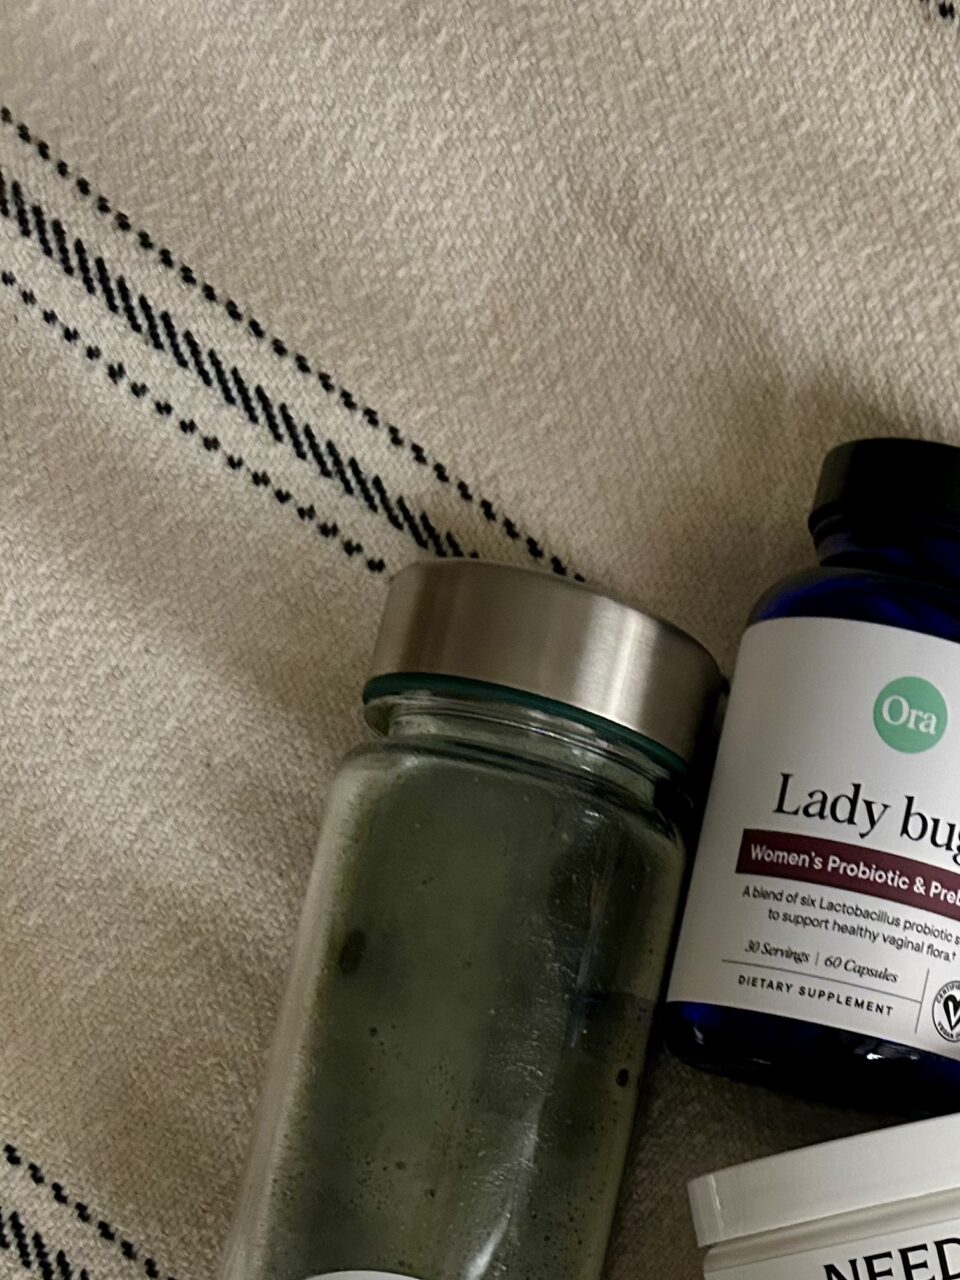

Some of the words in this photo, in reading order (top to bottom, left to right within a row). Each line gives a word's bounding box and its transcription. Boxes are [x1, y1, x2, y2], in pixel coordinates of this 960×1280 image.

[882, 695, 937, 735] Ora
[773, 772, 891, 839] Lady
[750, 843, 823, 871] Women's
[827, 857, 909, 890] Probiotic
[913, 876, 927, 895] &
[742, 887, 751, 898] A
[752, 888, 784, 902] blend
[785, 892, 799, 904] of
[801, 894, 816, 907] six
[819, 897, 901, 927] Lactobacillus
[902, 918, 953, 944] probiotic
[768, 908, 780, 922] to
[782, 911, 829, 931] support
[832, 920, 879, 944] healthy
[882, 934, 924, 956] vaginal
[744, 939, 760, 954] 30
[761, 942, 811, 965] Servings
[824, 955, 842, 969] 60
[843, 960, 899, 984] Capsules
[738, 974, 793, 993] DIETARY
[799, 985, 894, 1017] SUPPLEMENT
